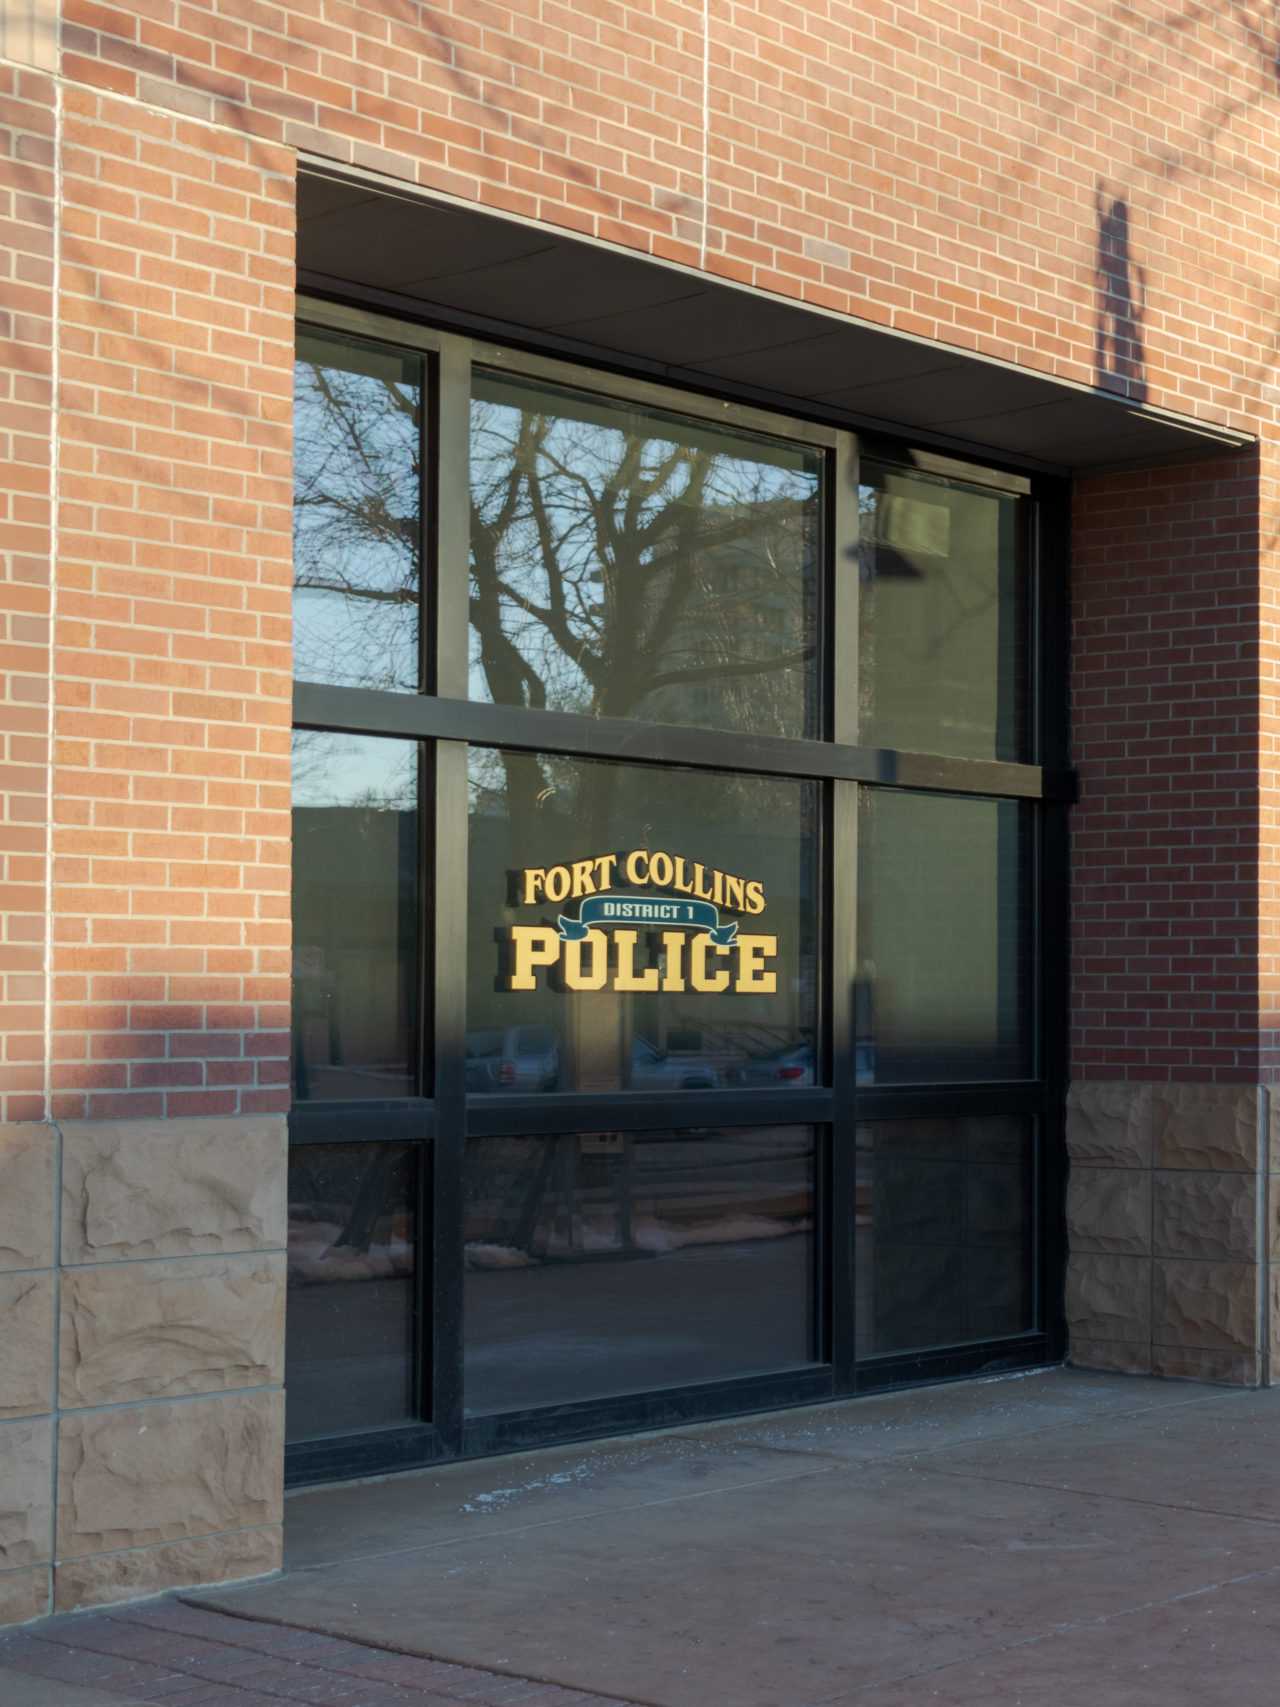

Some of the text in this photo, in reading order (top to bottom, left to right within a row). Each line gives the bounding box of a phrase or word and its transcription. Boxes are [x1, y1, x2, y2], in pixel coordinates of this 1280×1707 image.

[523, 850, 766, 915] FORT COLLINS
[604, 902, 694, 920] DISTRICT 1
[511, 925, 777, 993] POLICE
